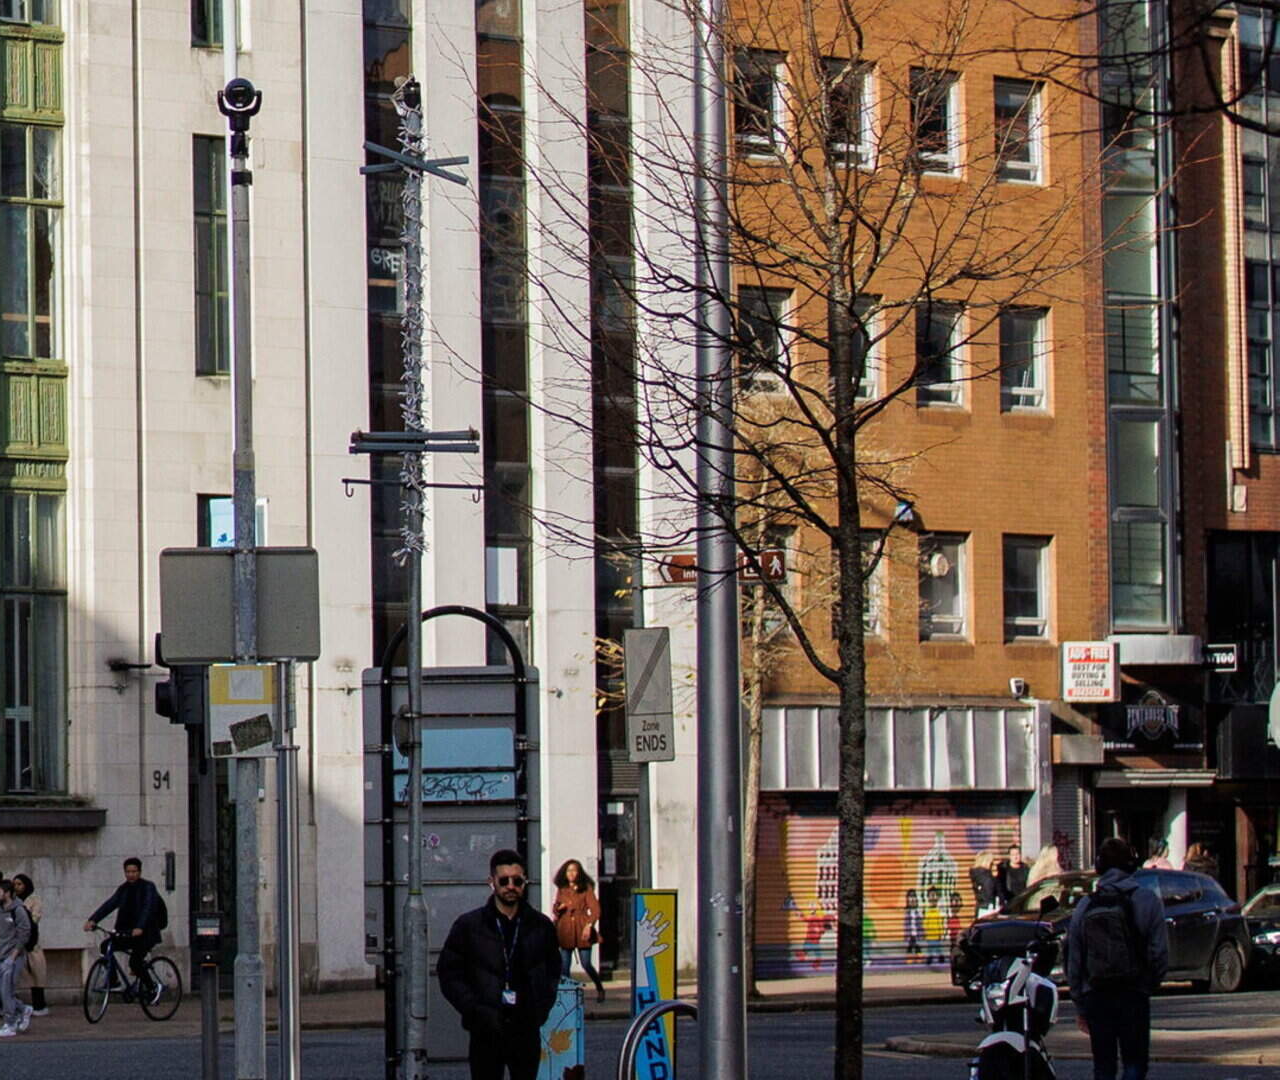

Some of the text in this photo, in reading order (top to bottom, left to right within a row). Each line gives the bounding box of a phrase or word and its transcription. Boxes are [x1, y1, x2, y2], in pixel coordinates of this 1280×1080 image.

[641, 719, 660, 732] Zone
[635, 734, 667, 752] ENDS
[153, 770, 170, 790] 94
